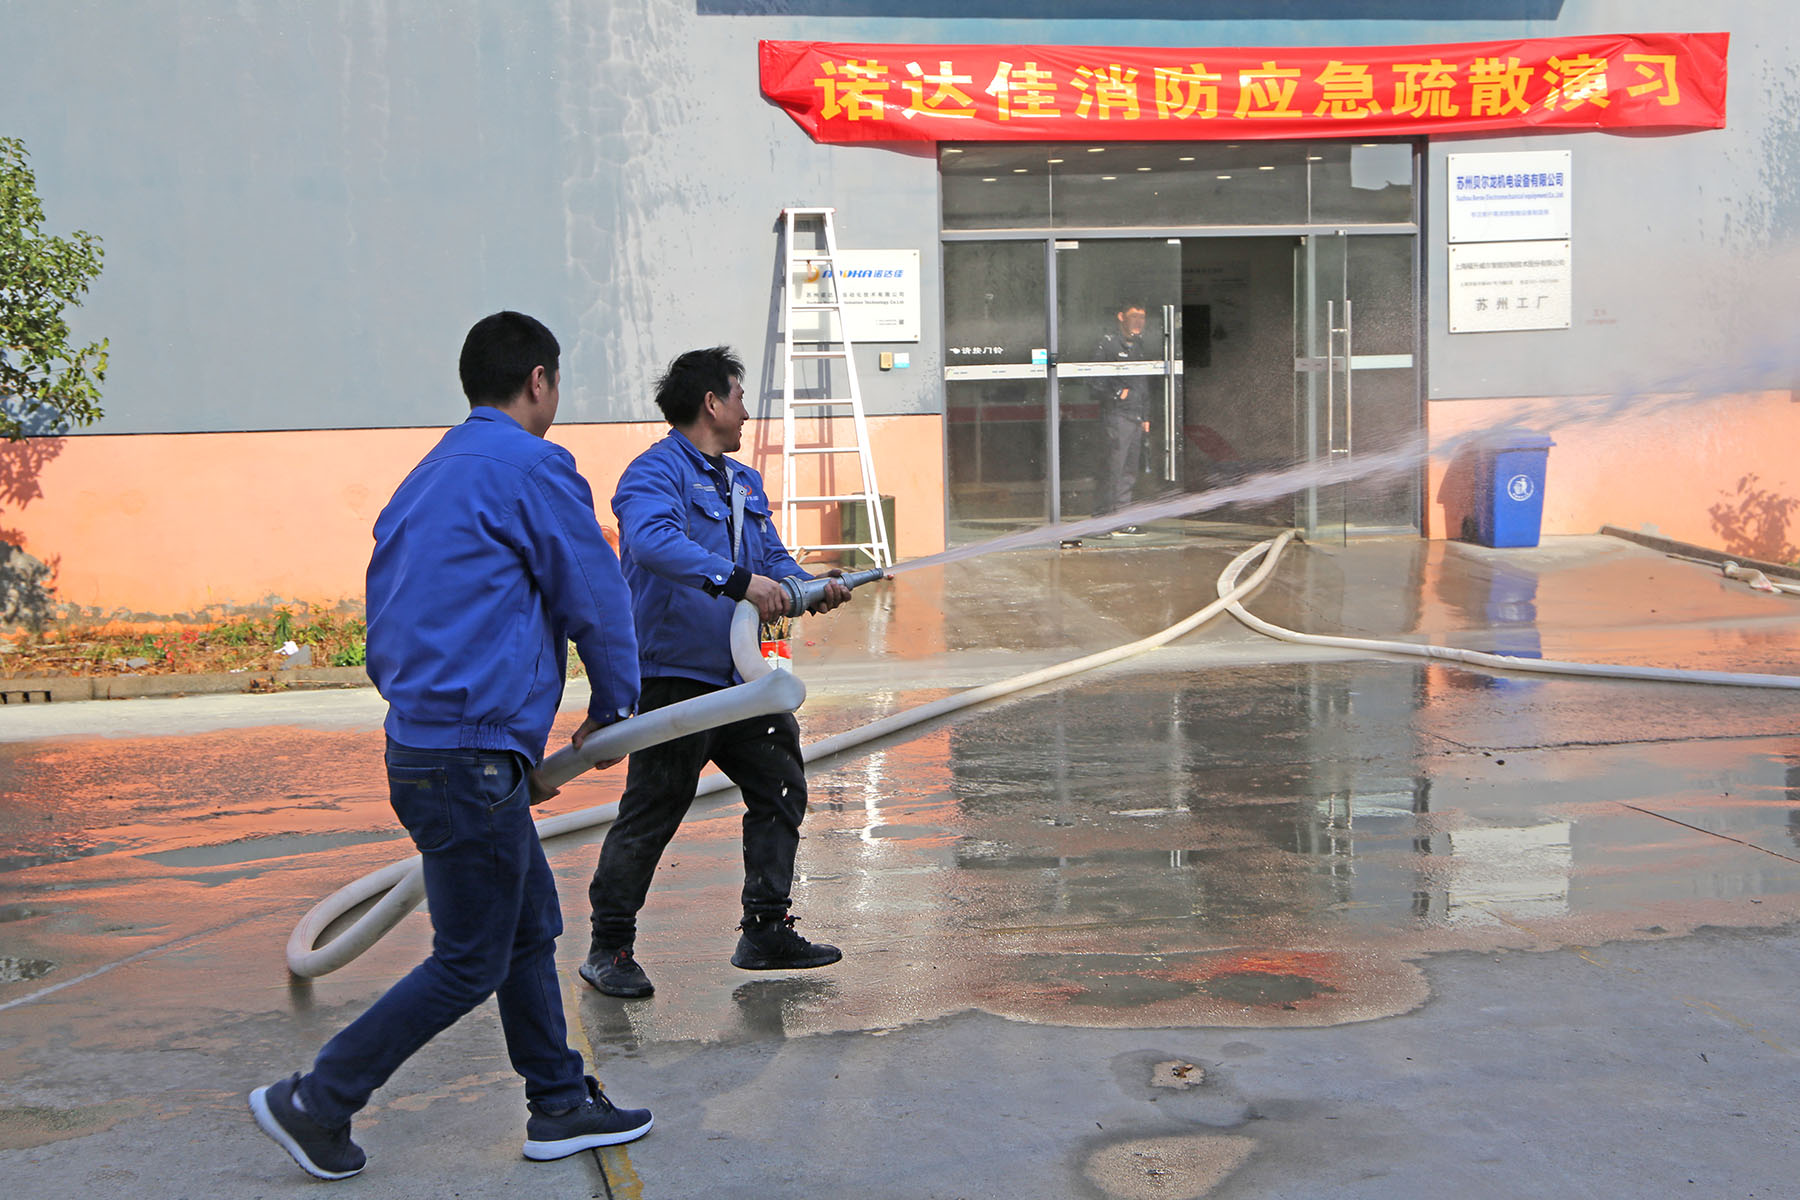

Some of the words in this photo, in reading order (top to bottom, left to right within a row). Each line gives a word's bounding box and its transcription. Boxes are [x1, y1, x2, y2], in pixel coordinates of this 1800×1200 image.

[814, 54, 1681, 122] 诺达佳消防应急疏散演习
[873, 269, 904, 278] 诺达佳
[1475, 295, 1549, 311] 苏州工厂
